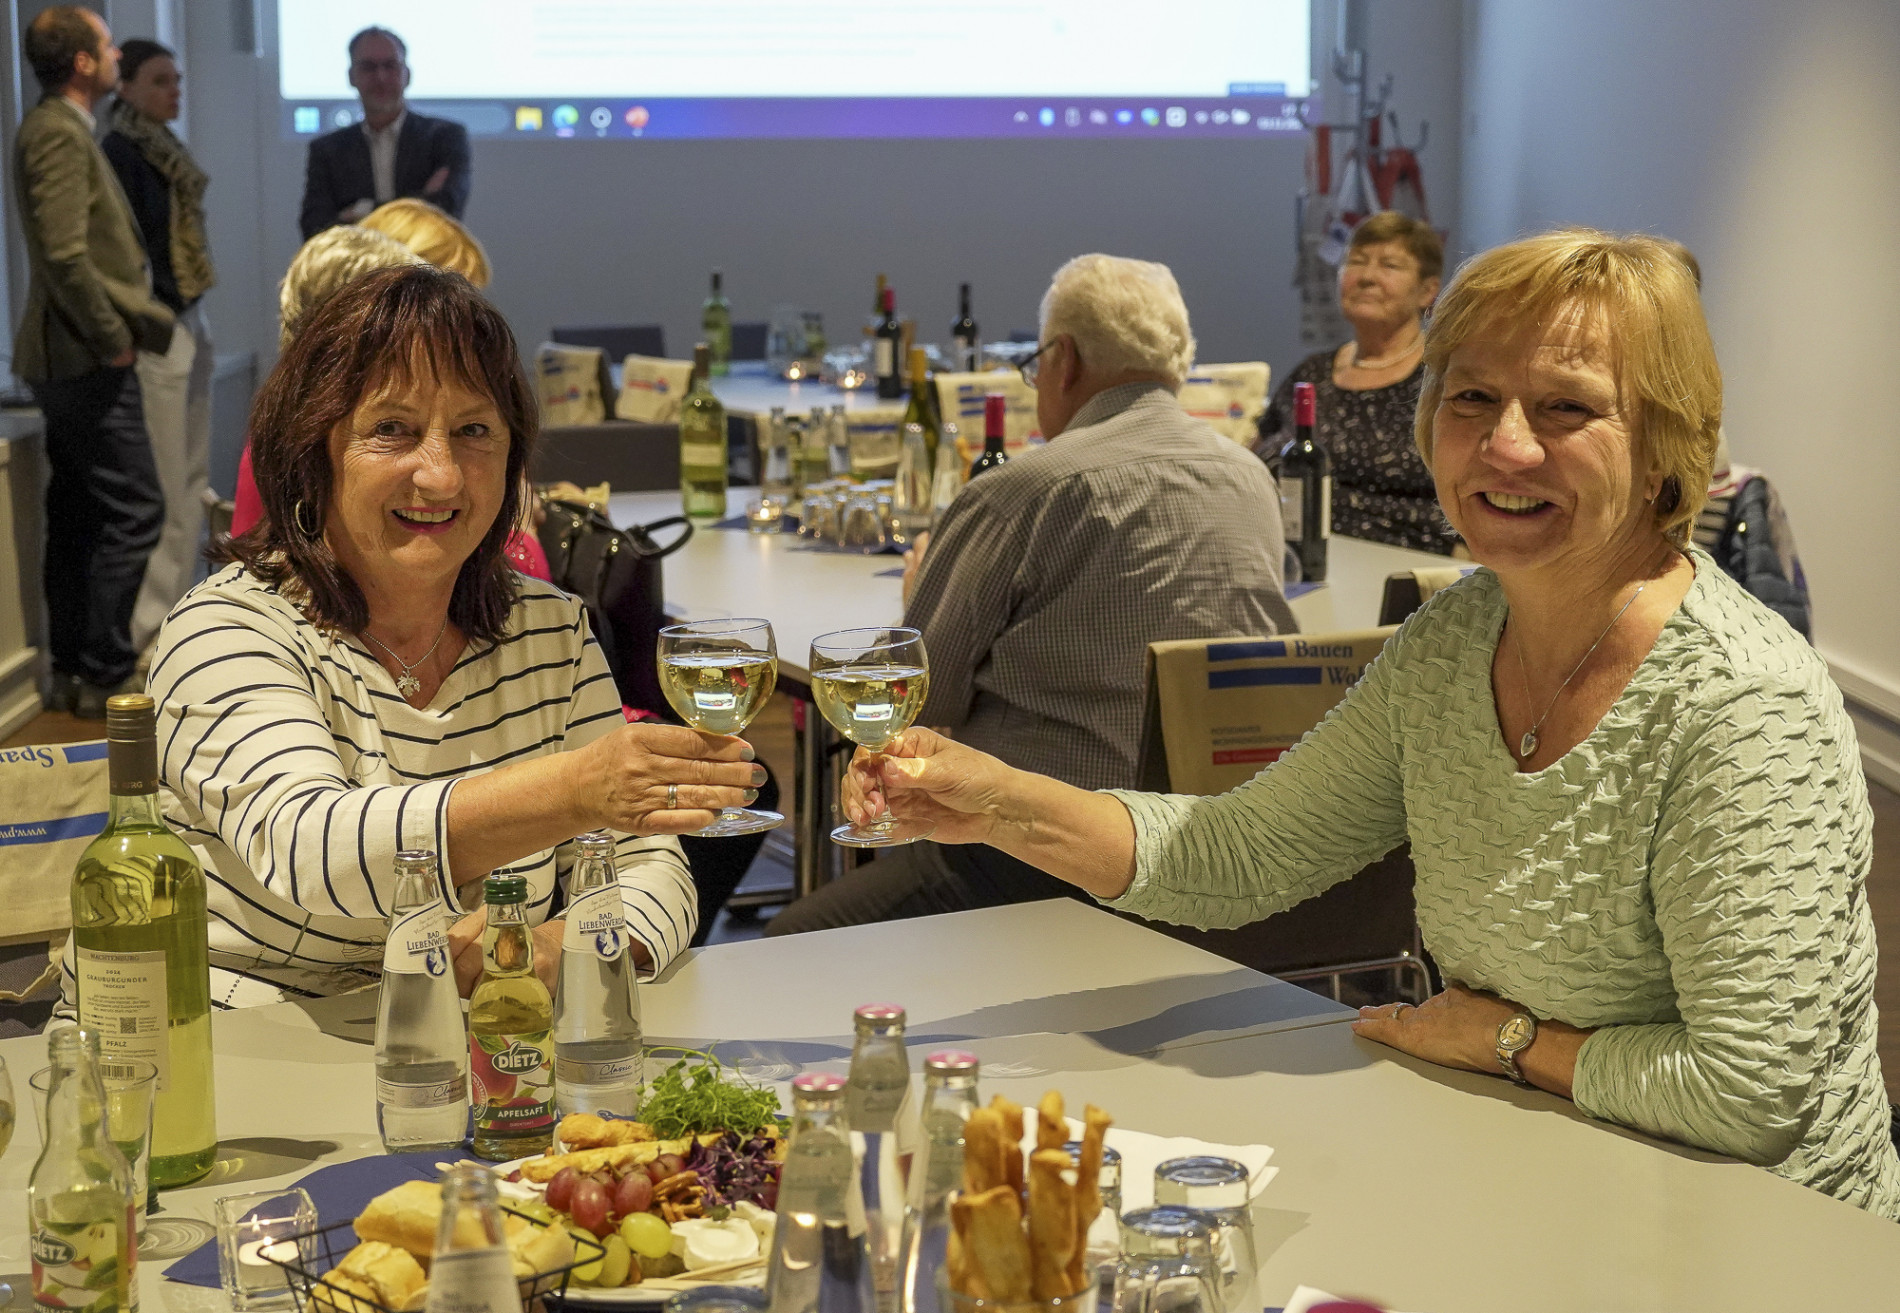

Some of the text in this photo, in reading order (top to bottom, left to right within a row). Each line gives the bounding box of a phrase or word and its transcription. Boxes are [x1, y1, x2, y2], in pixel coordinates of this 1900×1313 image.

[1295, 640, 1353, 658] Bauen
[598, 912, 613, 920] BAD
[427, 930, 440, 940] BAD
[498, 1052, 539, 1069] DIETZ
[600, 1064, 633, 1076] Classic
[497, 1106, 544, 1118] APFELSAFT
[32, 1238, 67, 1261] DIETZ
